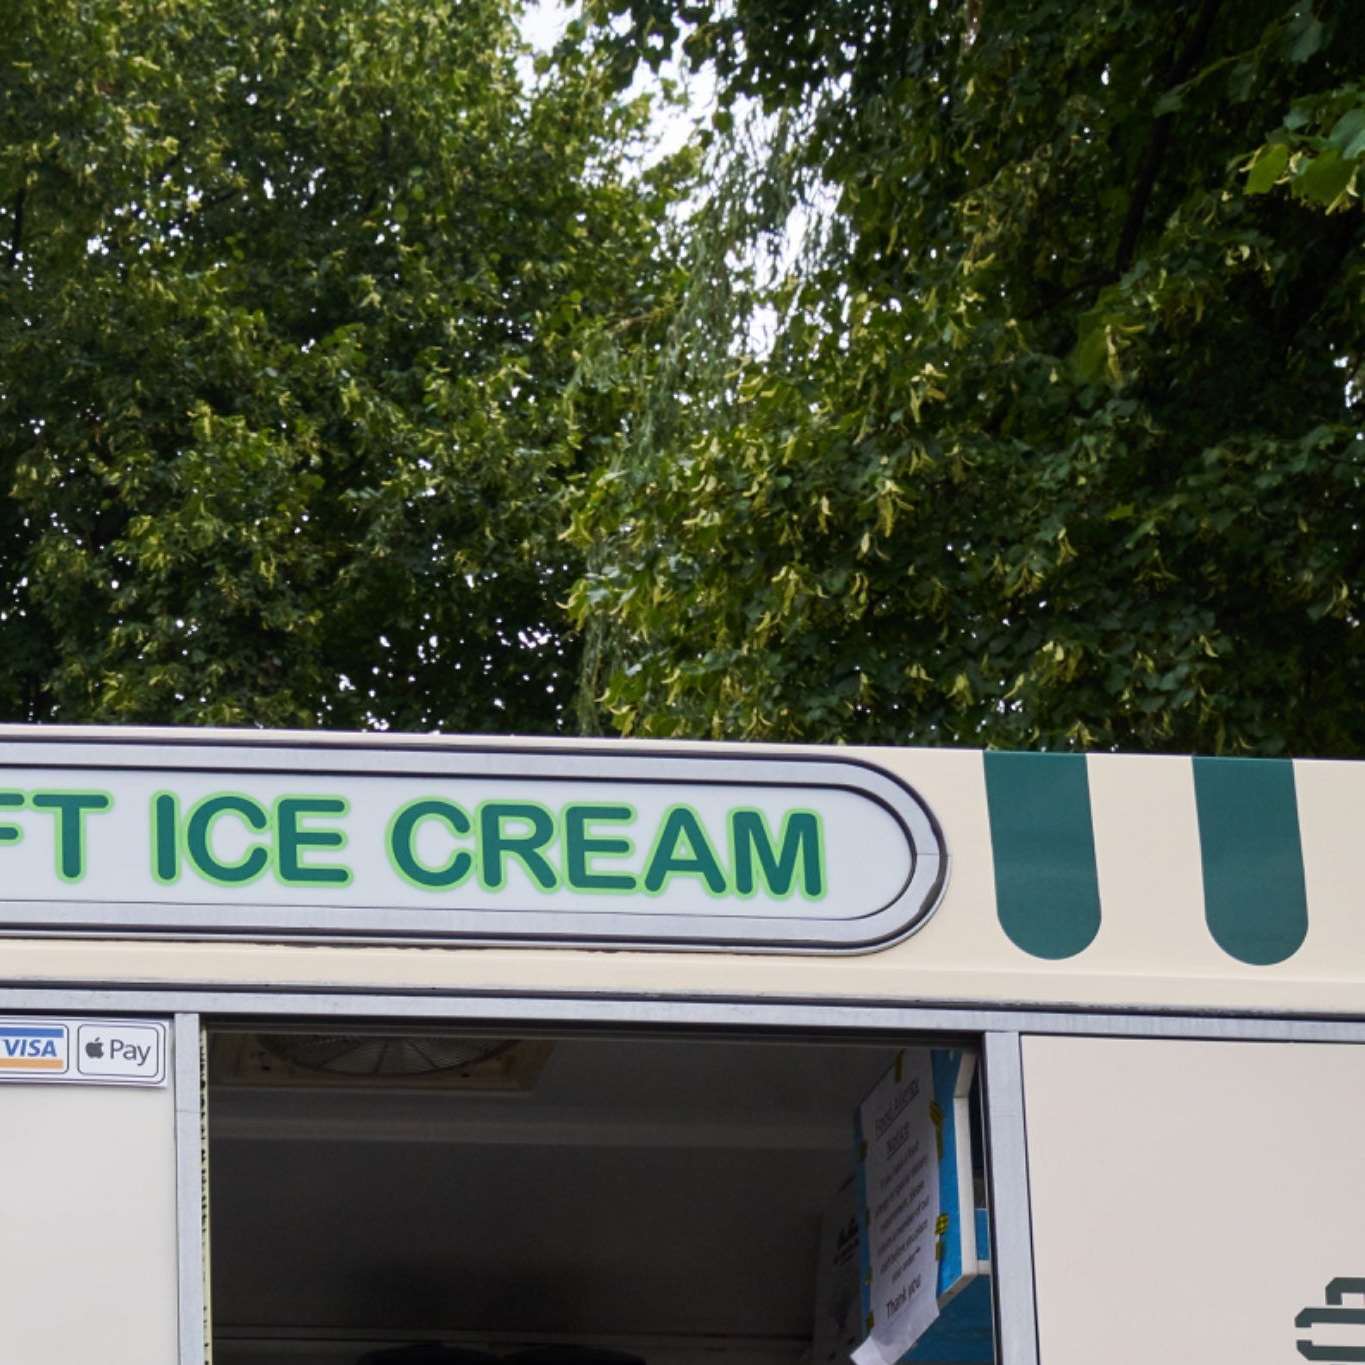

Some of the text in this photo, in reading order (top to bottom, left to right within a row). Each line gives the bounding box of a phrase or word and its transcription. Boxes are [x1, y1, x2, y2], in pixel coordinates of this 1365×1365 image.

[150, 793, 352, 887] ICE
[386, 796, 827, 902] CREAM
[2, 1038, 58, 1059] VISA
[109, 1038, 151, 1066] Pay
[886, 1272, 923, 1320] Thank you
